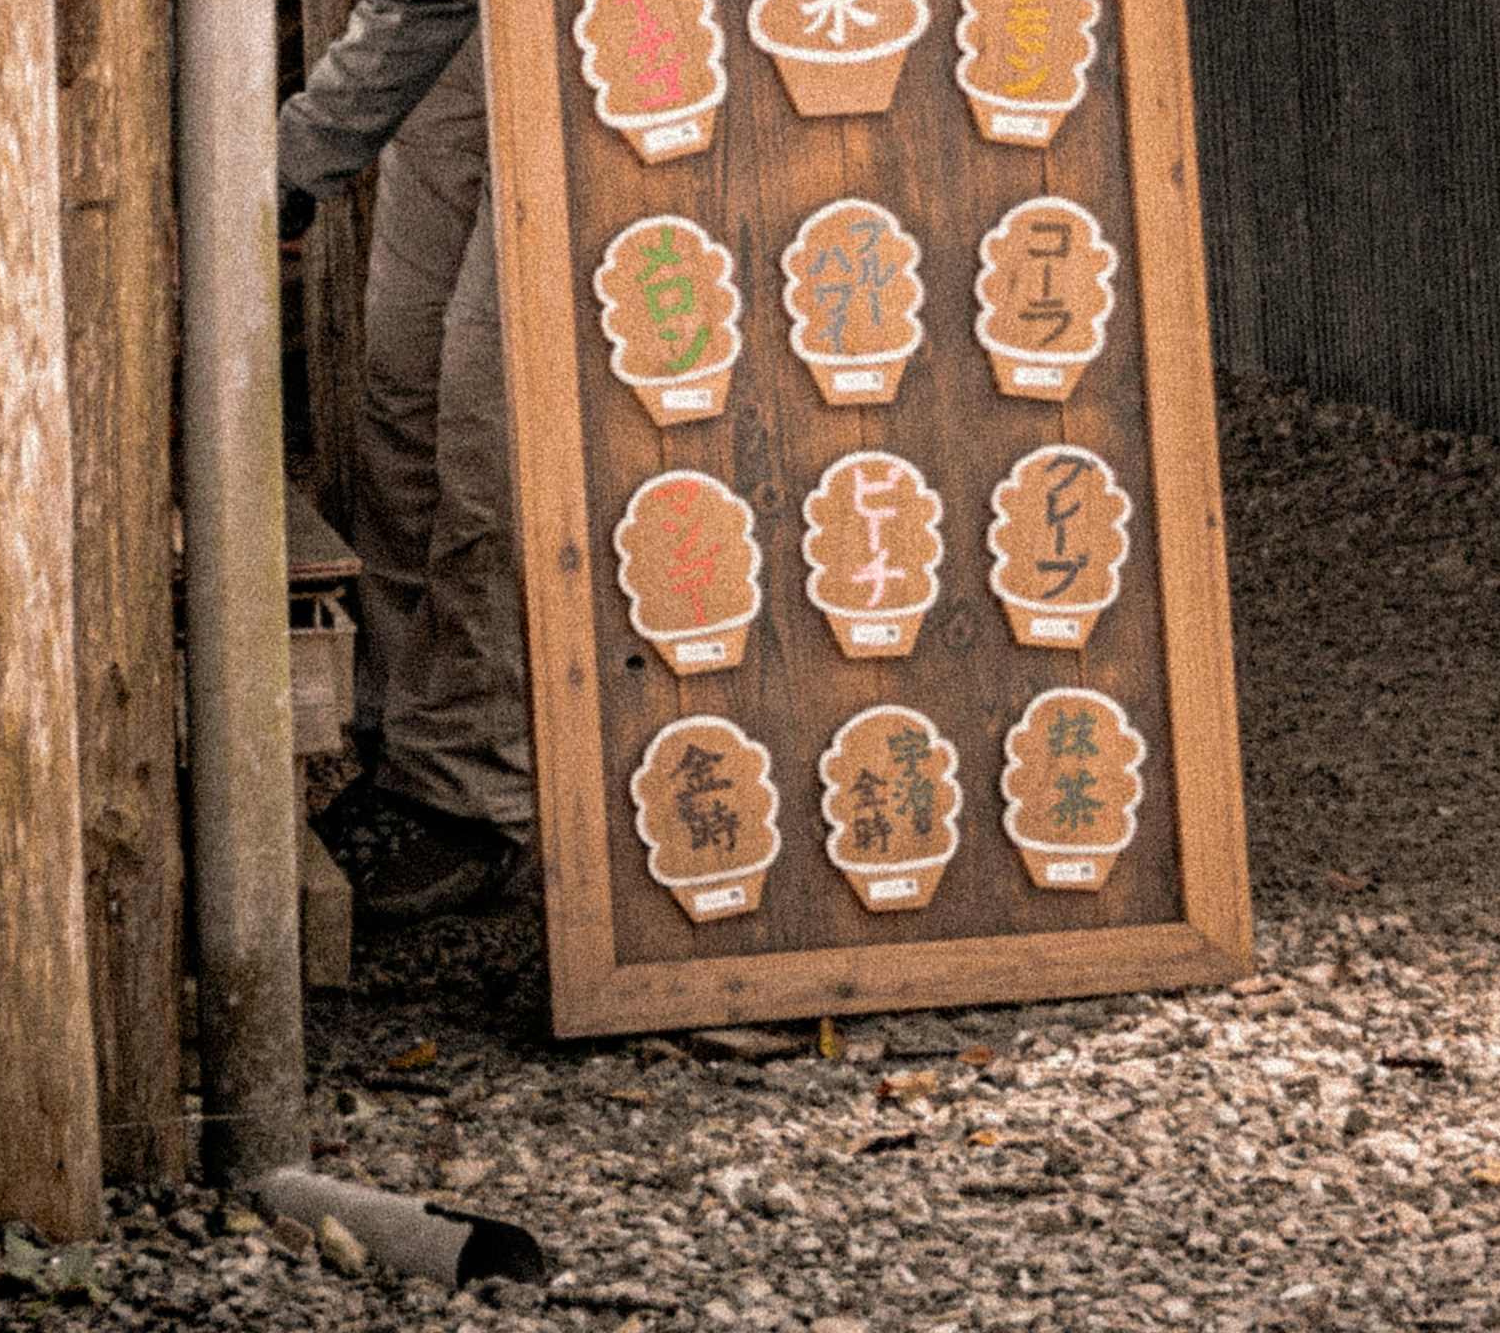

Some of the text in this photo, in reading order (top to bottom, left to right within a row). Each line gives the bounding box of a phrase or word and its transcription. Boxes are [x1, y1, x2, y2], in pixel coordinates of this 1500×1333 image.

[637, 226, 710, 372] メロン
[806, 244, 853, 354] ハワイ
[1018, 221, 1073, 348] コーラ
[650, 479, 718, 626] マンゴー
[851, 464, 909, 608] ピーチ
[1035, 453, 1097, 600] グレープ
[1047, 707, 1106, 832] 抹茶
